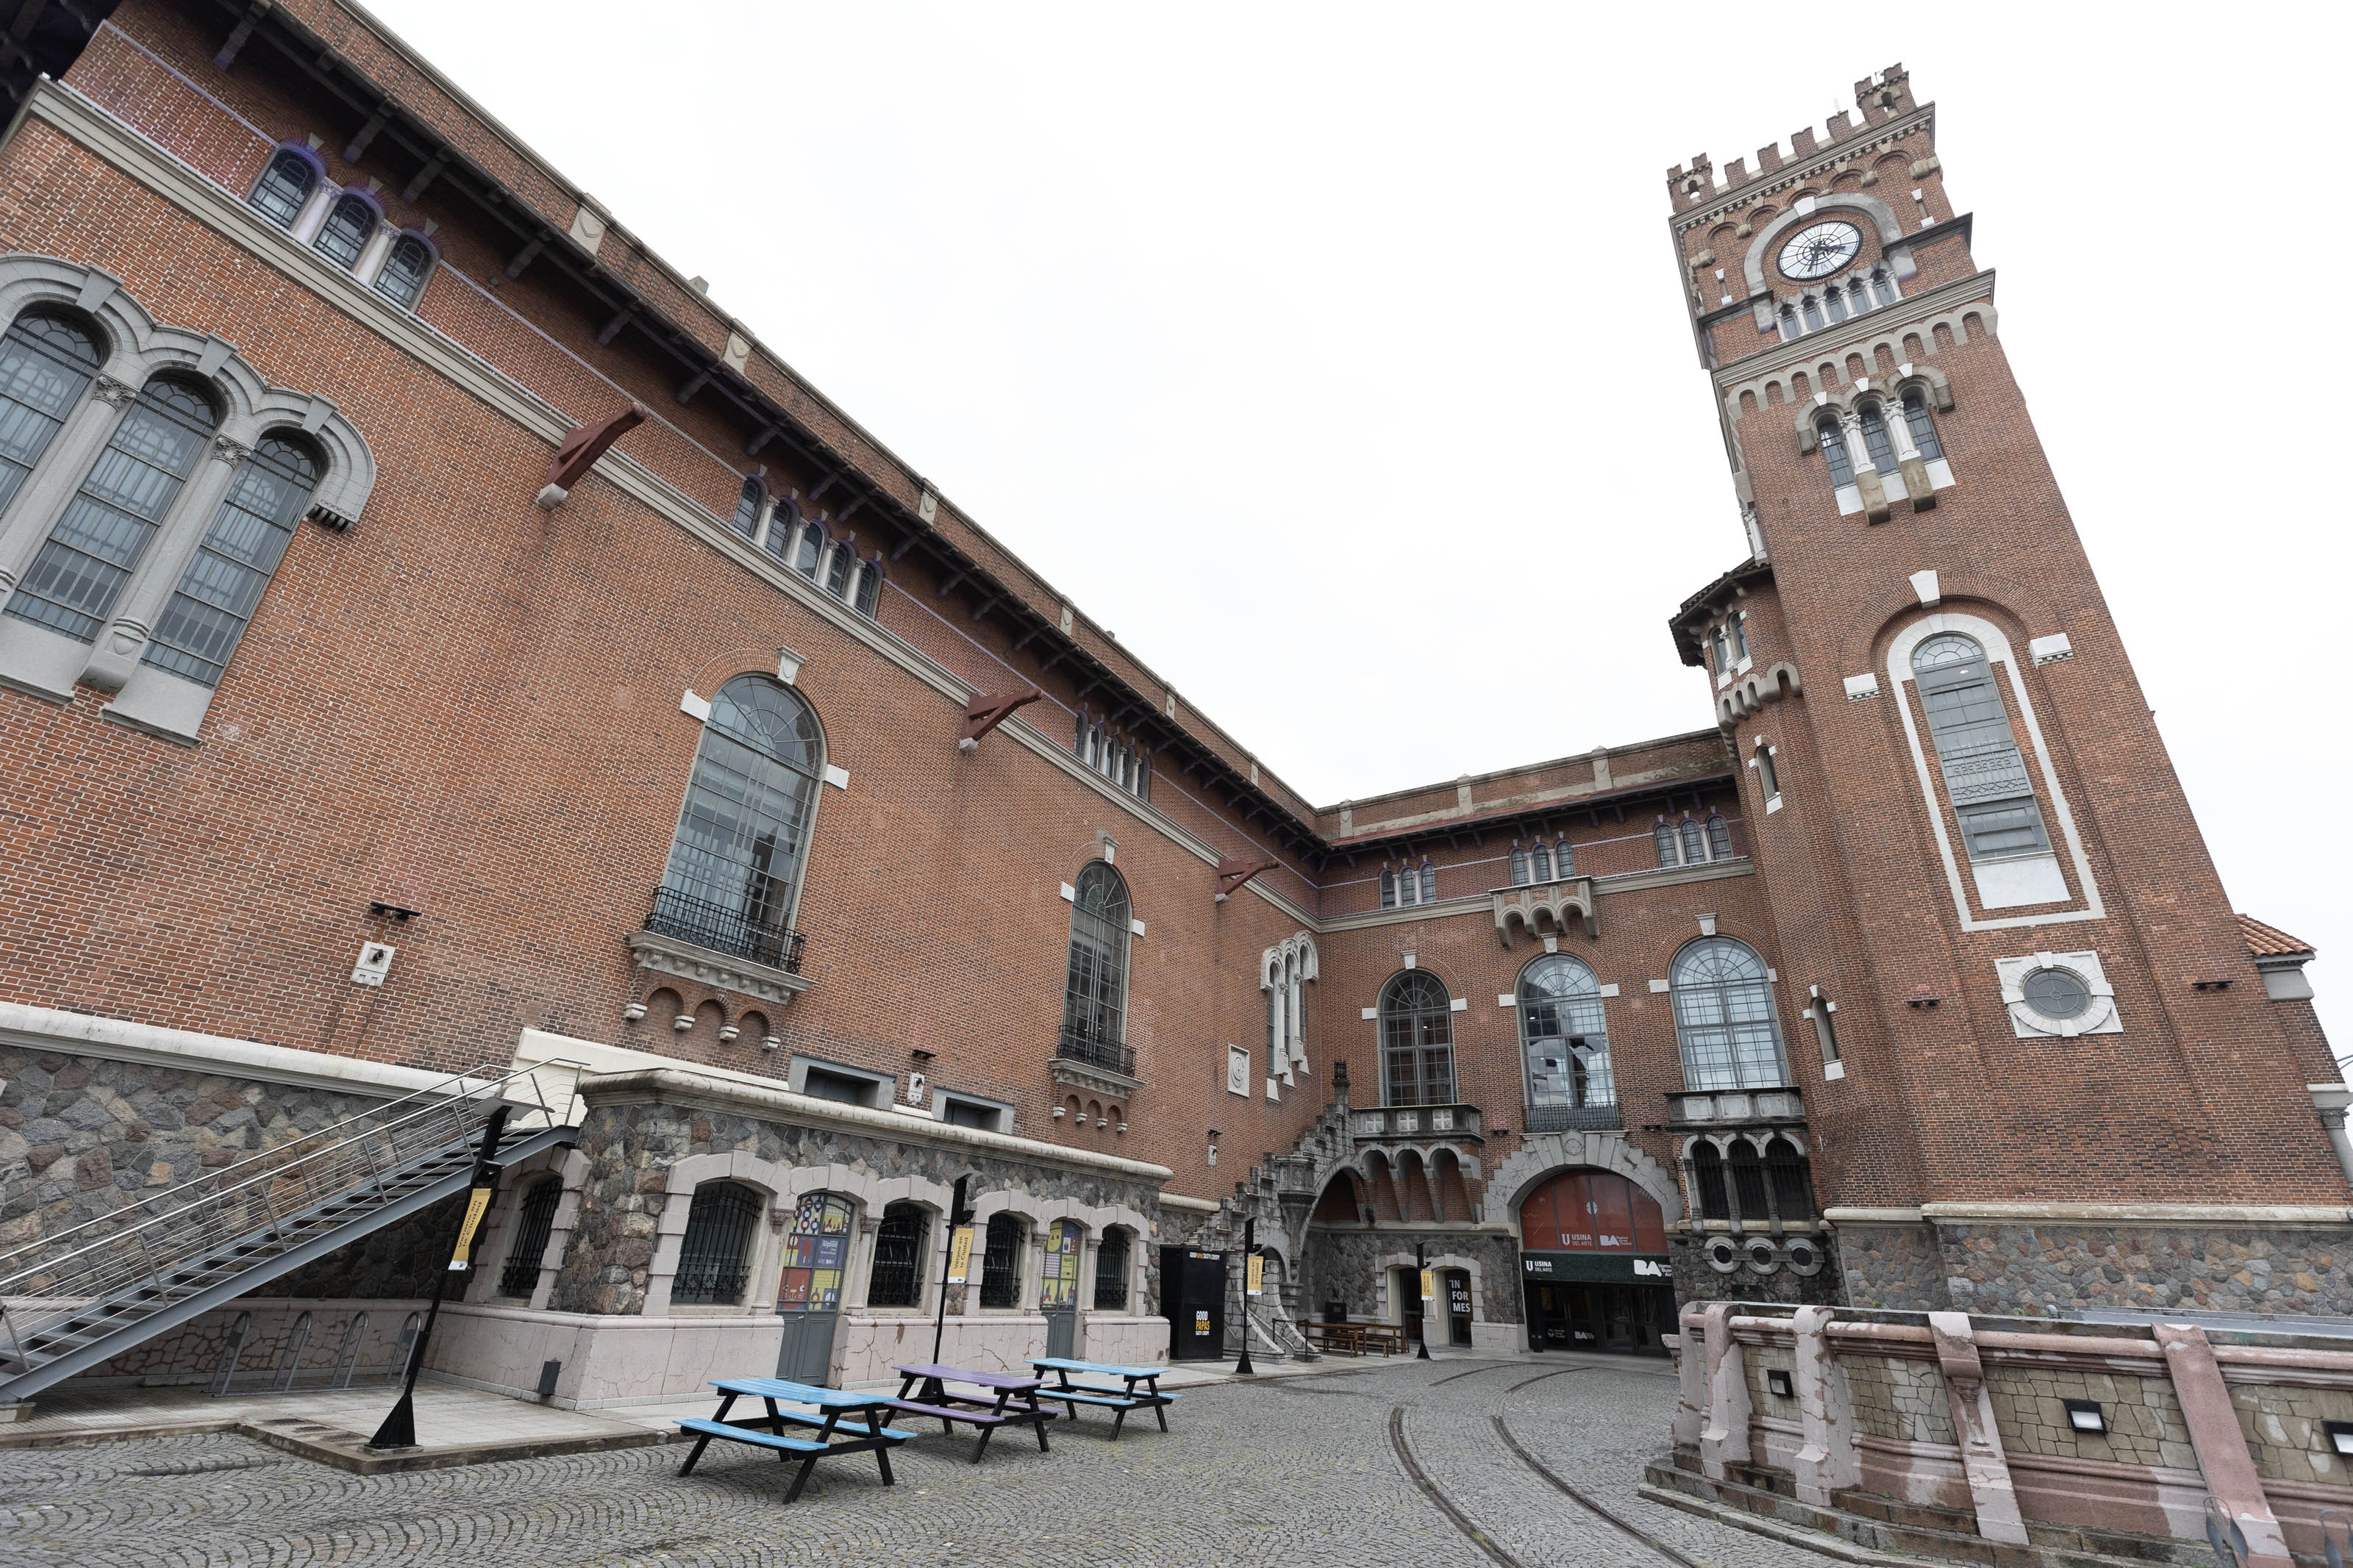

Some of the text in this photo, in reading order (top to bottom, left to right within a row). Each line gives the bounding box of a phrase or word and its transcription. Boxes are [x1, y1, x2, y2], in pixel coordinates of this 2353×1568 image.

[459, 1200, 477, 1247] Verano en
[463, 1202, 482, 1247] la Ciudad
[959, 1236, 963, 1244] en
[1634, 1259, 1662, 1277] BA
[1452, 1290, 1468, 1300] FOR
[1452, 1302, 1471, 1312] MES
[1196, 1310, 1208, 1321] GOOD
[1196, 1320, 1210, 1330] PAPAS
